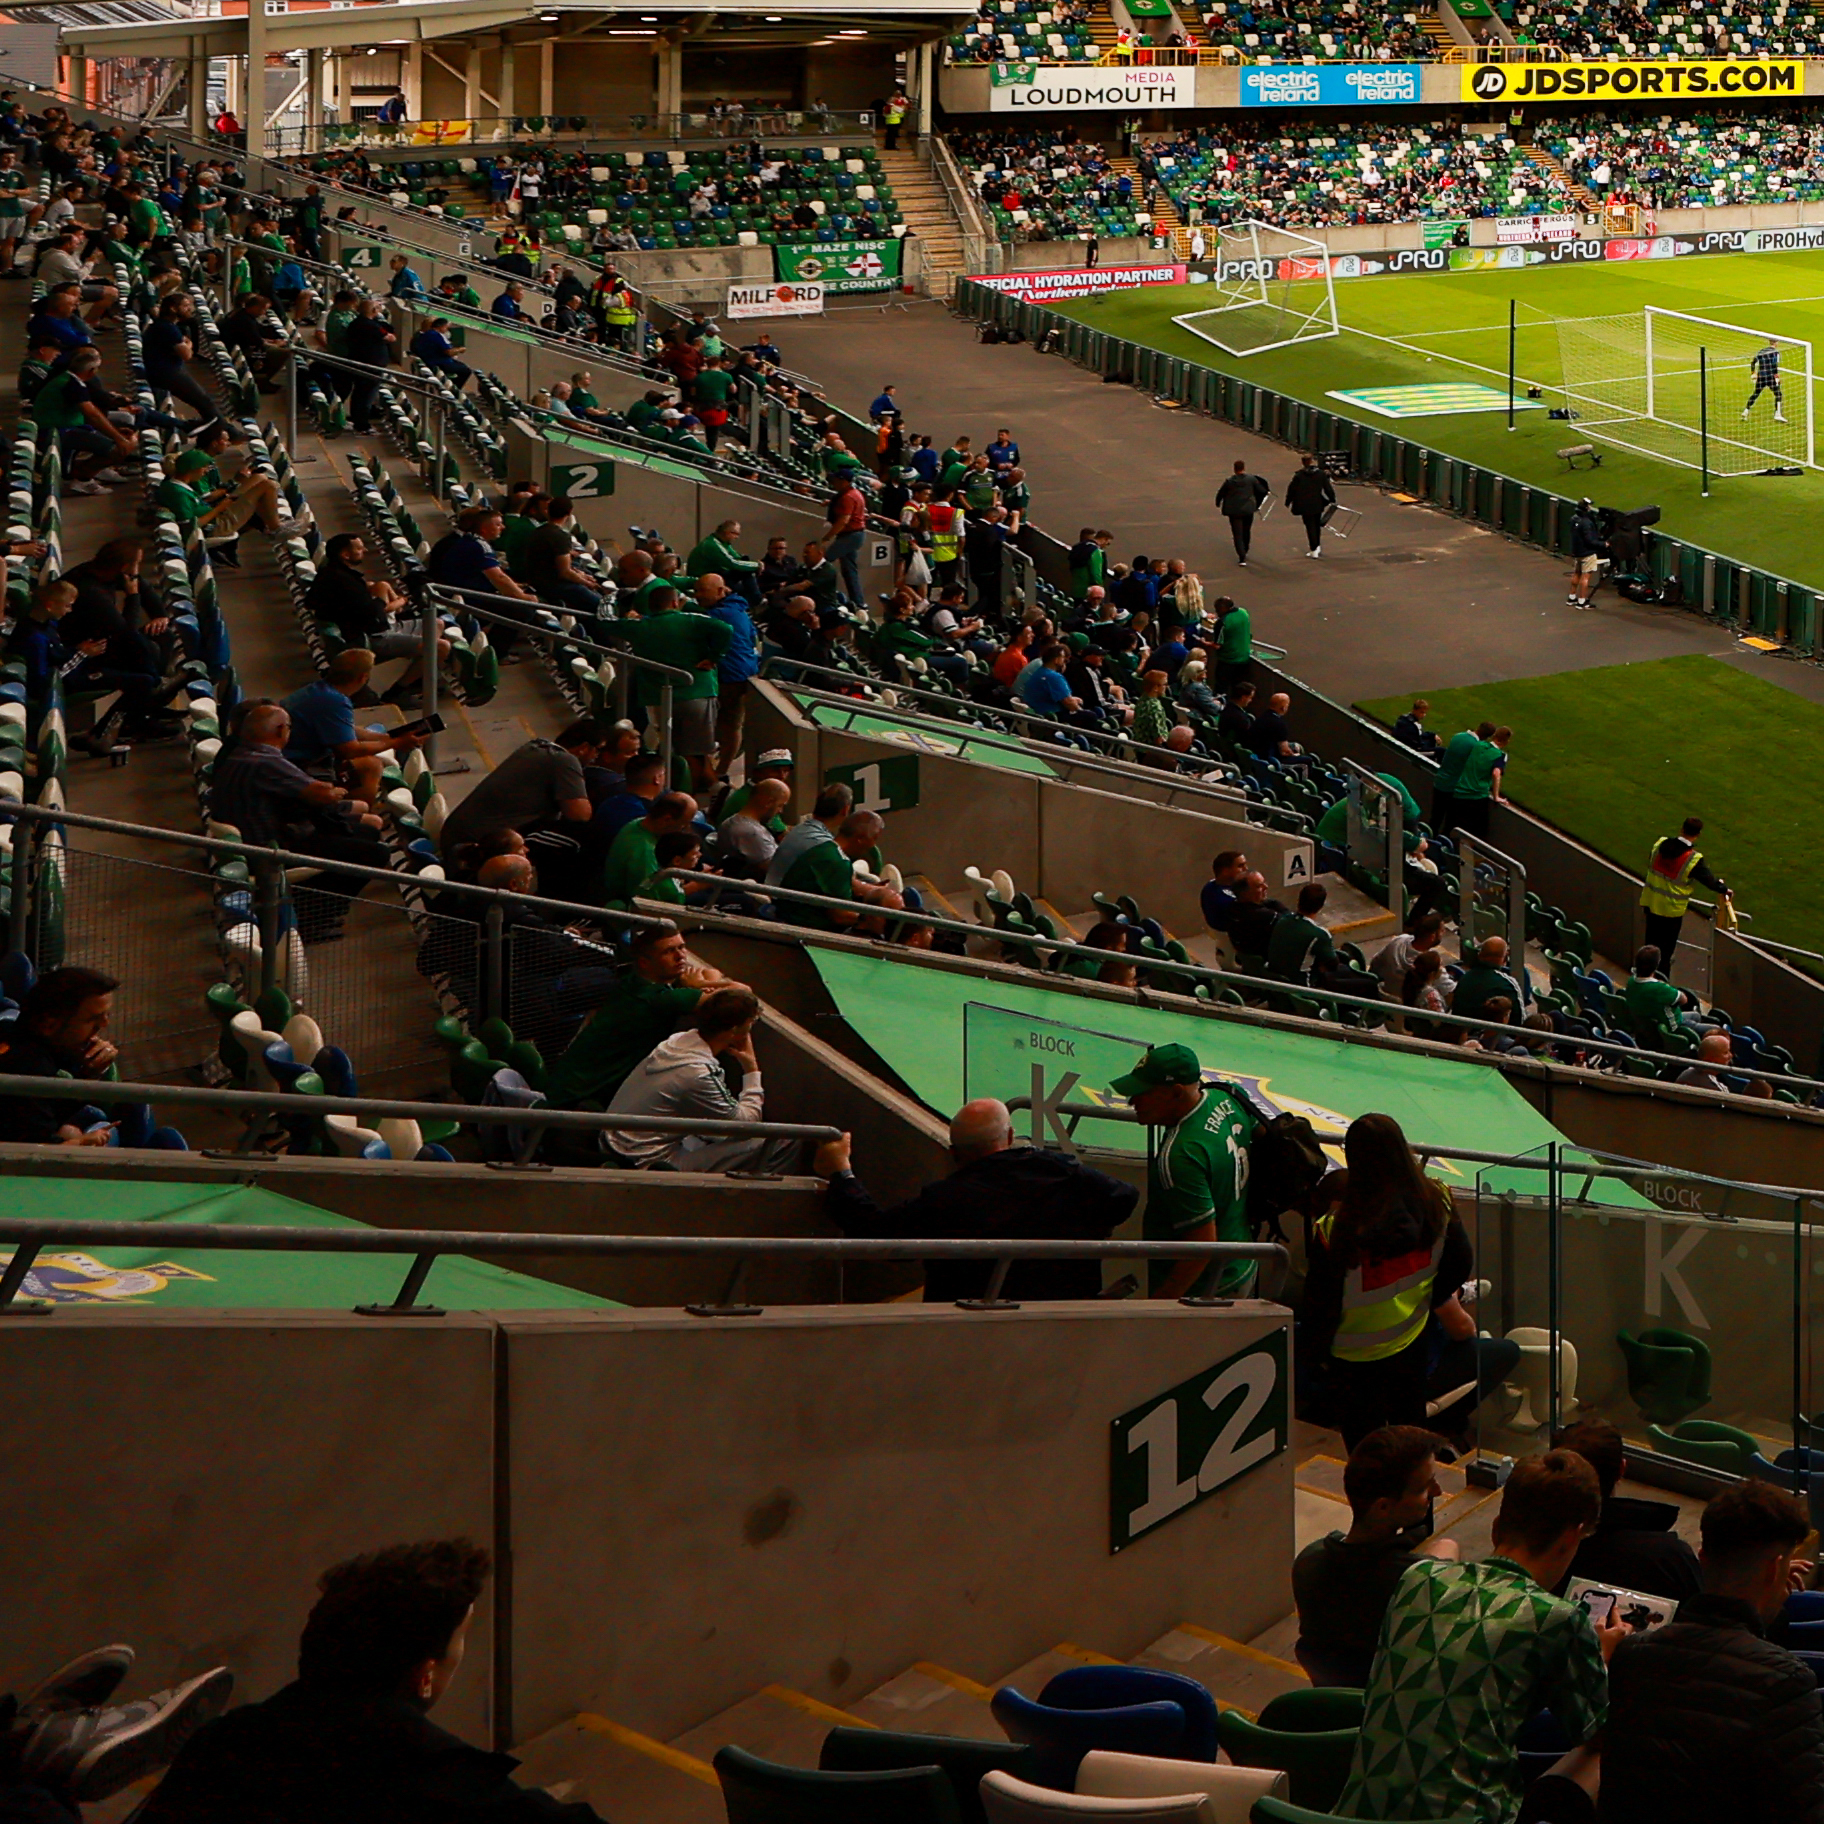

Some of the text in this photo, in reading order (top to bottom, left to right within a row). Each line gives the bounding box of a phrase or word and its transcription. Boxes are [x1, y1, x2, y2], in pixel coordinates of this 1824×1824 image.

[1125, 72, 1176, 83] MEDIA
[1247, 71, 1319, 88] electric
[1345, 69, 1415, 87] electric
[1514, 65, 1796, 96] JDSPORTS.COM
[1011, 87, 1176, 107] LOUDMOUTH
[1259, 85, 1319, 102] Ireland
[1356, 84, 1415, 101] Ireland
[1587, 214, 1596, 224] 5
[462, 245, 469, 254] E
[811, 243, 850, 253] MAZE
[855, 241, 887, 251] NISC
[1154, 237, 1164, 248] 3
[350, 248, 373, 267] 4
[1034, 272, 1113, 289] HYDRATION
[1114, 268, 1174, 284] PARTNER
[543, 303, 553, 313] D
[567, 465, 600, 498] 2
[876, 545, 888, 560] B
[853, 762, 891, 812] 1
[1288, 855, 1307, 879] A
[1030, 1032, 1076, 1057] BLOCK
[1030, 1062, 1083, 1164] K
[1204, 1099, 1235, 1135] FRANCE
[1643, 1180, 1702, 1209] BLOCK
[1644, 1215, 1711, 1331] K
[1127, 1351, 1277, 1537] 12
